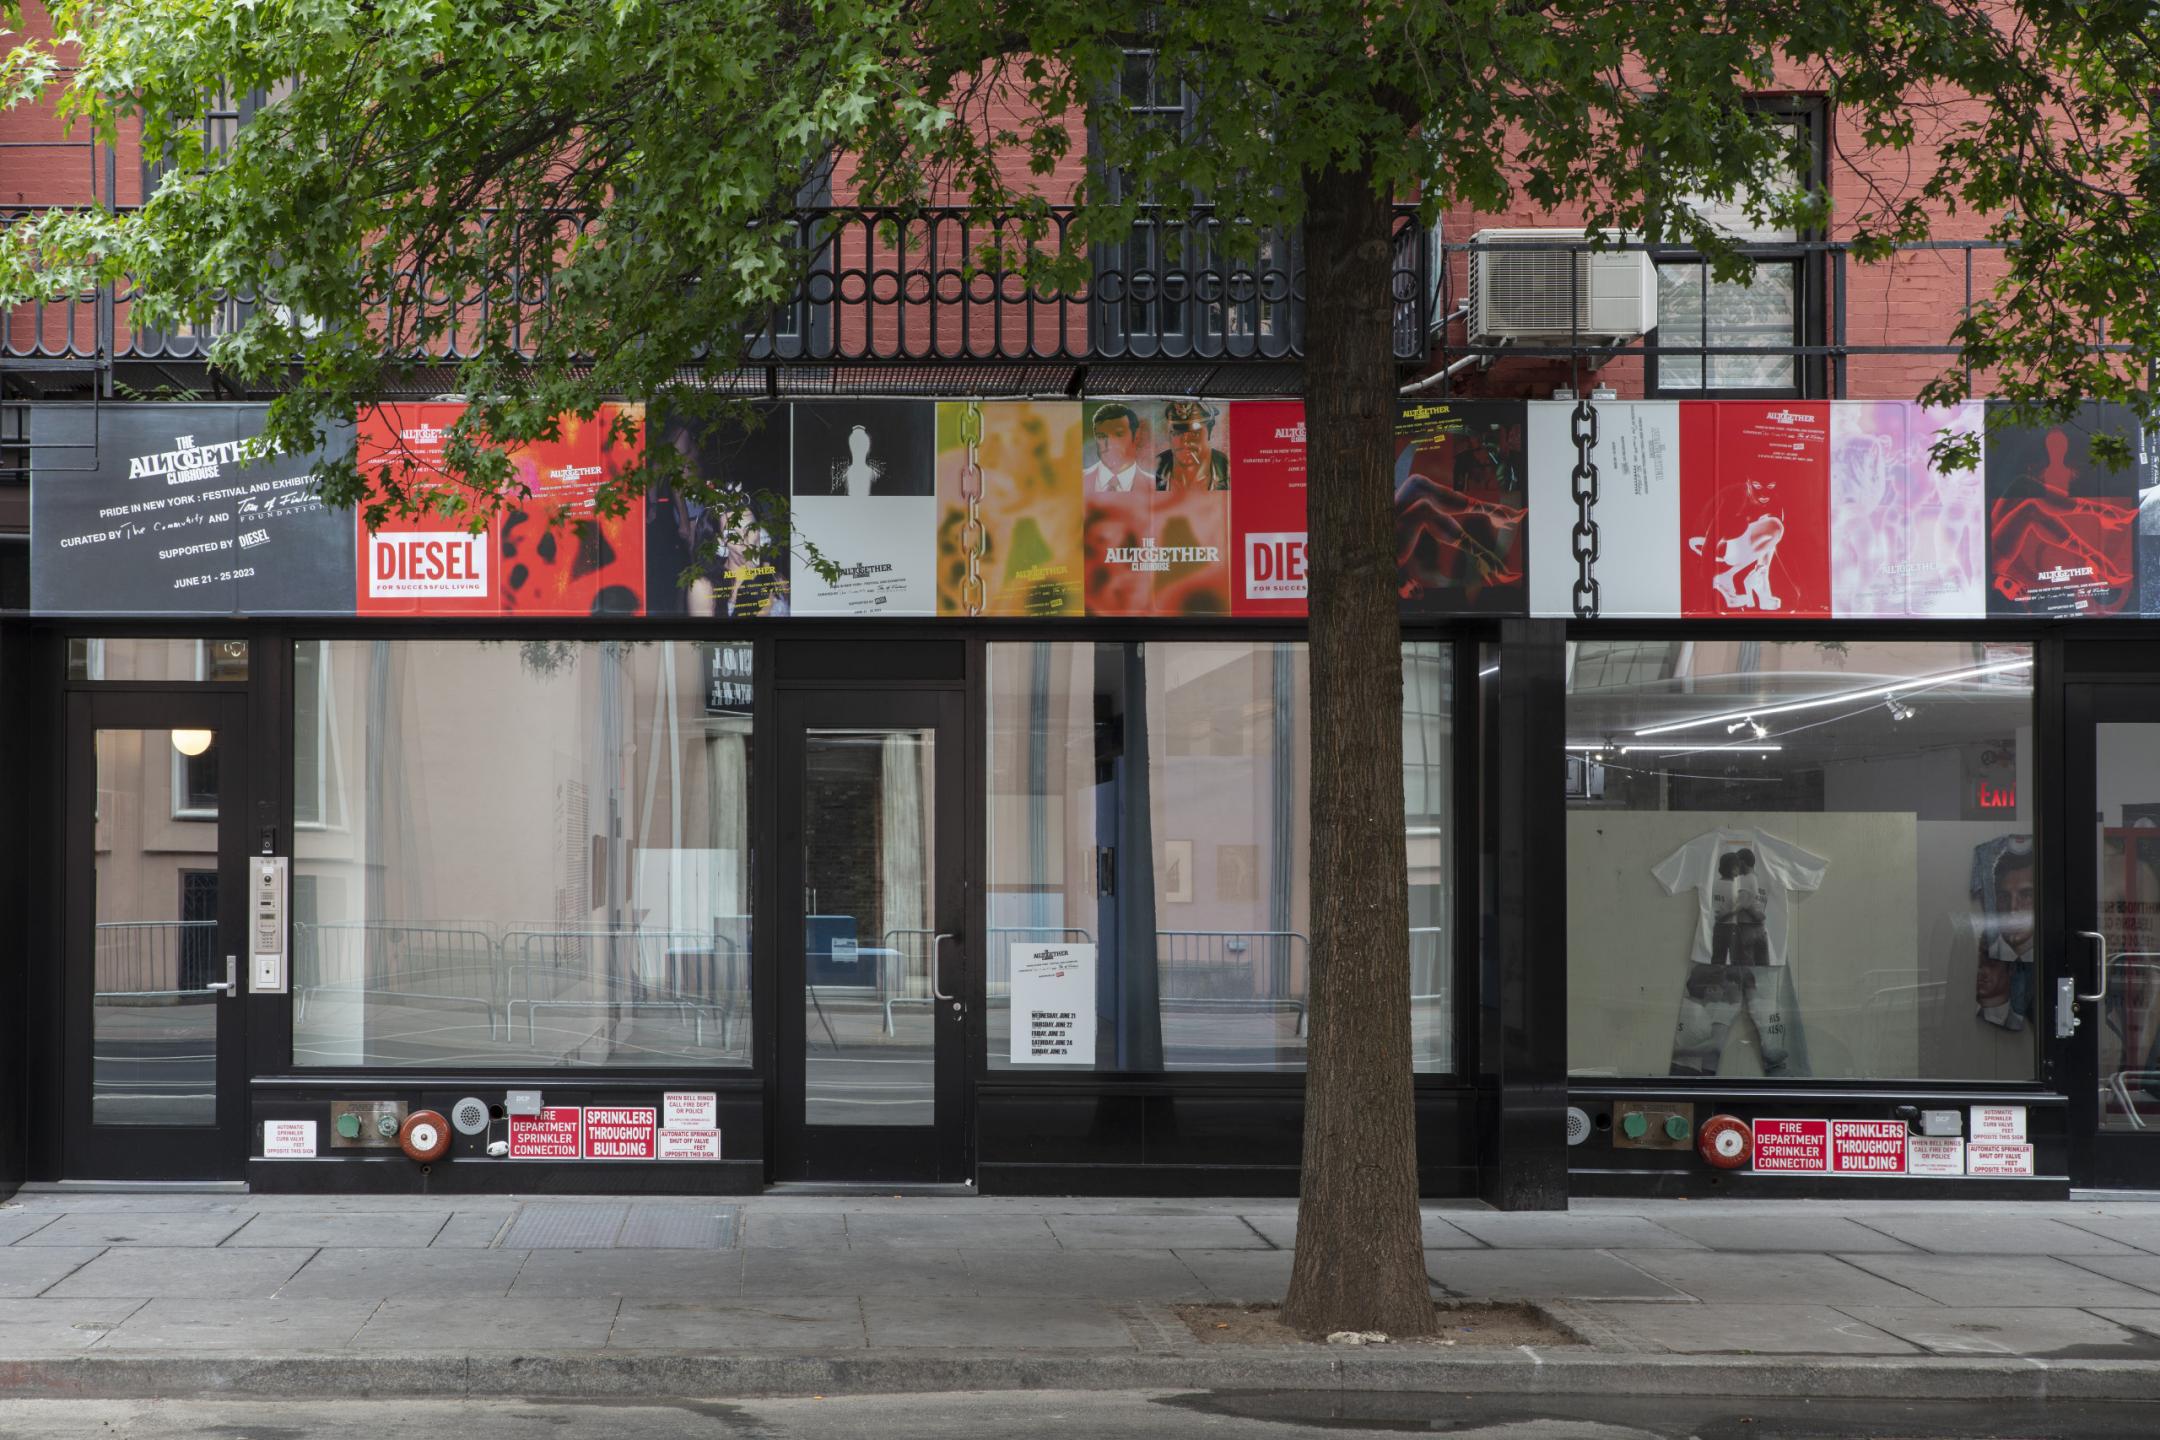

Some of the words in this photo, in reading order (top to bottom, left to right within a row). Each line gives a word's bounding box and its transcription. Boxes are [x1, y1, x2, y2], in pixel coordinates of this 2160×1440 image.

[1274, 428, 1307, 438] ALLTOG
[175, 435, 195, 450] THE
[167, 465, 220, 485] CLUBHOUSE
[99, 506, 129, 518] PRIDE
[131, 503, 141, 513] IN
[142, 500, 165, 511] NEW
[167, 495, 195, 507] YORK
[202, 487, 248, 501] FESTIVAL
[250, 482, 271, 493] AND
[60, 533, 107, 548] CURATED
[108, 530, 122, 540] BY
[120, 522, 146, 540] The
[208, 513, 230, 524] AND
[237, 497, 259, 514] Tom
[264, 497, 277, 511] of
[158, 541, 218, 559] SUPPORTED
[219, 539, 233, 549] BY
[238, 528, 270, 548] DIESEL
[377, 541, 480, 580] DIESEL
[1104, 547, 1220, 563] ALLTOGETHER
[174, 576, 200, 589] JUNE
[201, 574, 212, 584] 21
[220, 571, 232, 582] 25
[233, 567, 255, 579] 2023
[587, 1111, 653, 1125] SPRINKLERS
[513, 1122, 577, 1132] DEPARTMENT
[588, 1126, 652, 1140] THROUGHOUT
[1779, 1122, 1803, 1133] FIRE
[1834, 1124, 1904, 1138] SPRINKLERS
[517, 1133, 573, 1144] SPRINKLER
[1757, 1134, 1825, 1145] DEPARTMENT
[514, 1145, 576, 1155] CONNECTION
[593, 1142, 647, 1156] BUILDING
[1762, 1146, 1820, 1157] SPRINKLER
[1836, 1139, 1902, 1154] THROUGHOUT
[1759, 1157, 1824, 1169] CONNECTION
[1842, 1156, 1898, 1170] BUILDING
